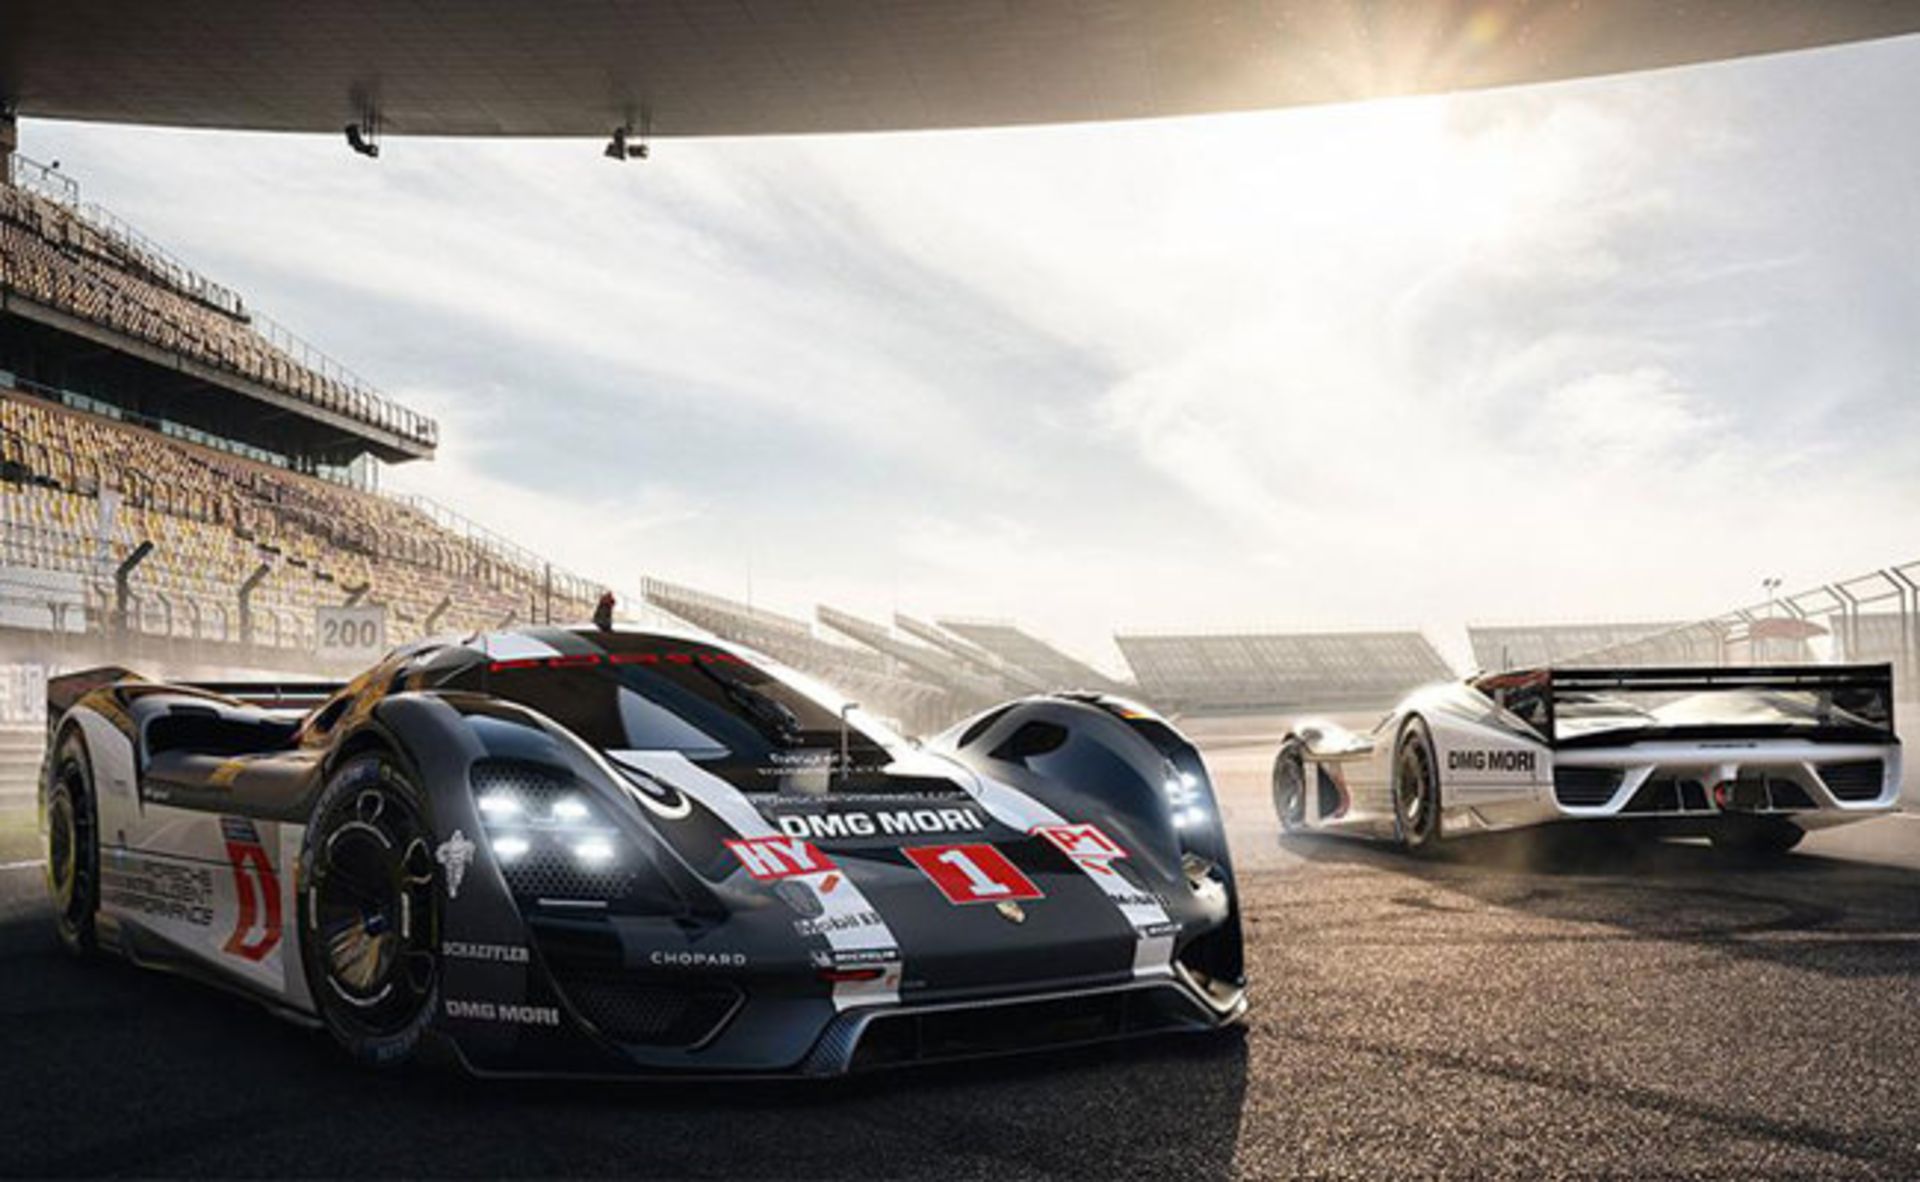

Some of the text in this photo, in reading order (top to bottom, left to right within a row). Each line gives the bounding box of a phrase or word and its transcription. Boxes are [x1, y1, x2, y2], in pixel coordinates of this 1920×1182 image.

[323, 618, 377, 648] 200
[1447, 750, 1537, 773] DMG MORI
[778, 807, 985, 838] DMG MORI
[731, 839, 818, 877] HY
[938, 848, 1013, 897] 1
[651, 949, 747, 967] CHOPARD
[446, 1000, 560, 1027] DMG MORI
